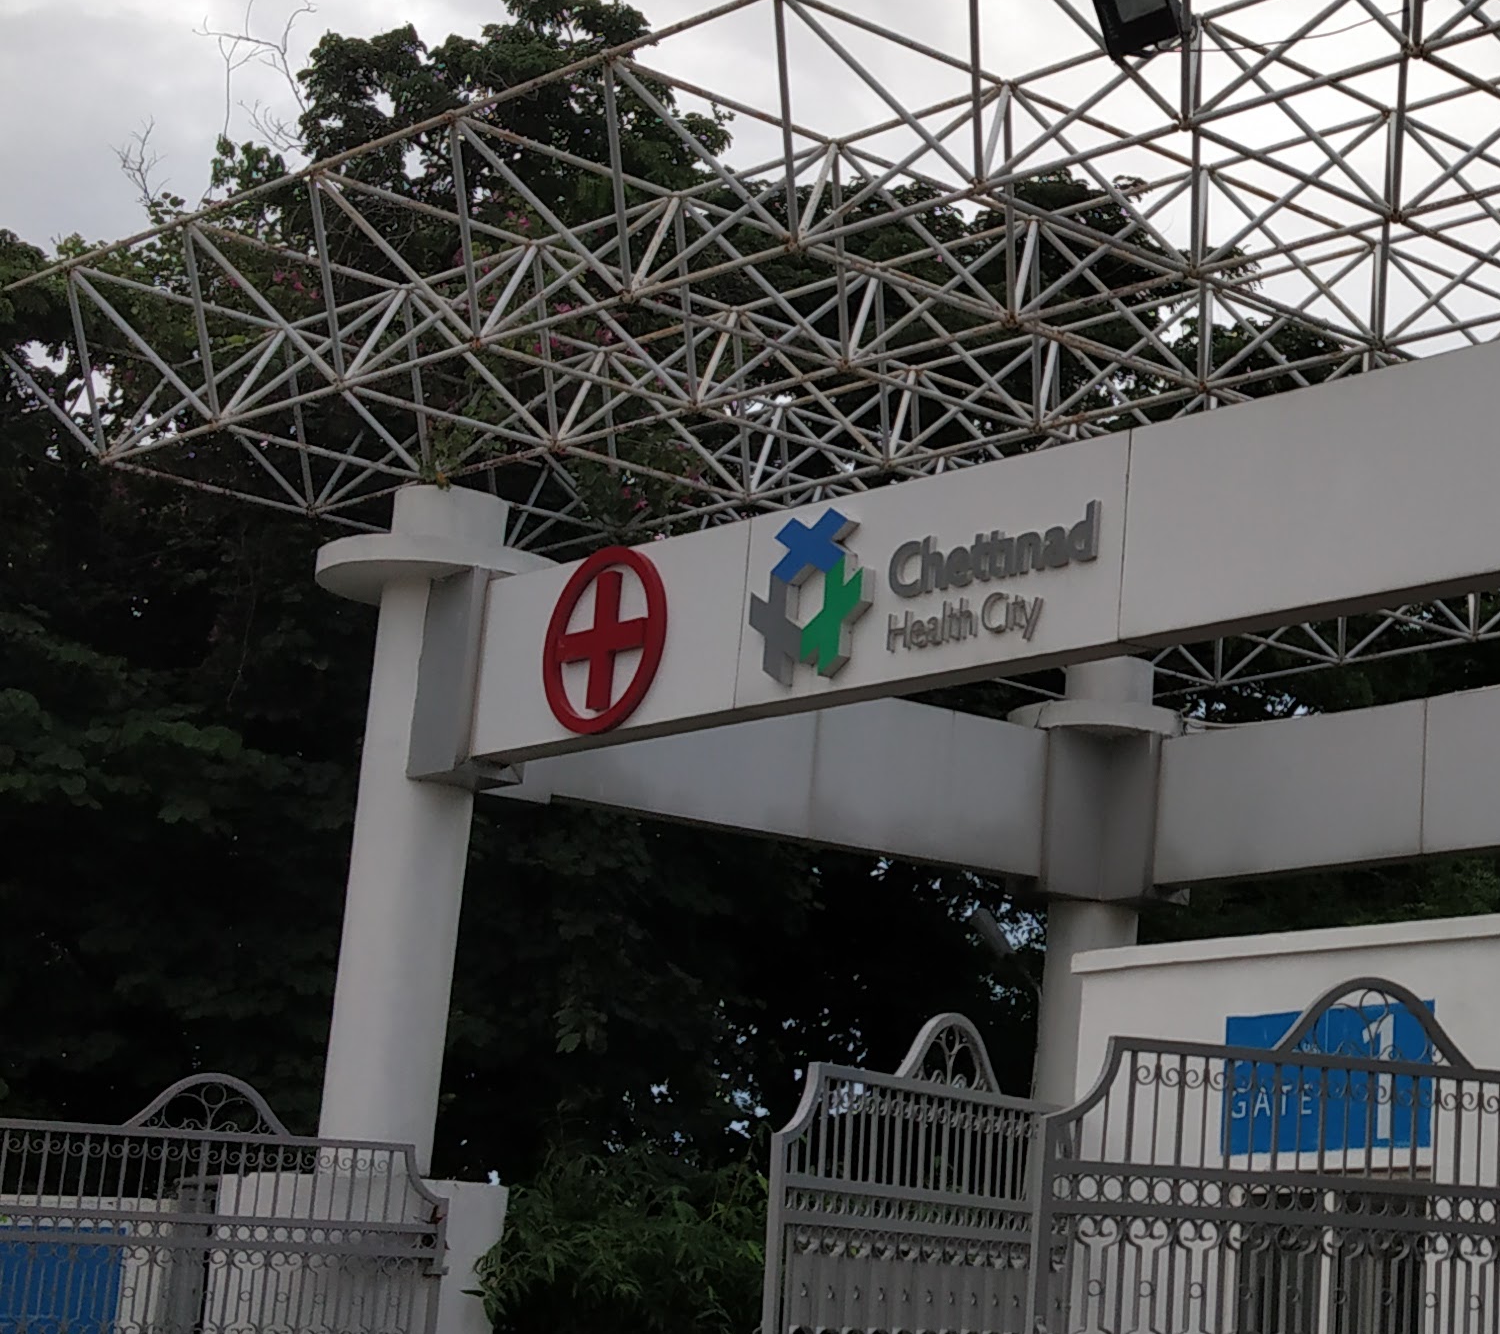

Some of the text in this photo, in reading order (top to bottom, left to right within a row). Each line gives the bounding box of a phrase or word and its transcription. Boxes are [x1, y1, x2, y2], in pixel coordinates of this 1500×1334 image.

[888, 499, 1102, 598] Chettinad
[886, 591, 1045, 653] Health City
[1231, 1083, 1314, 1119] GATE
[1362, 1014, 1394, 1140] 1
